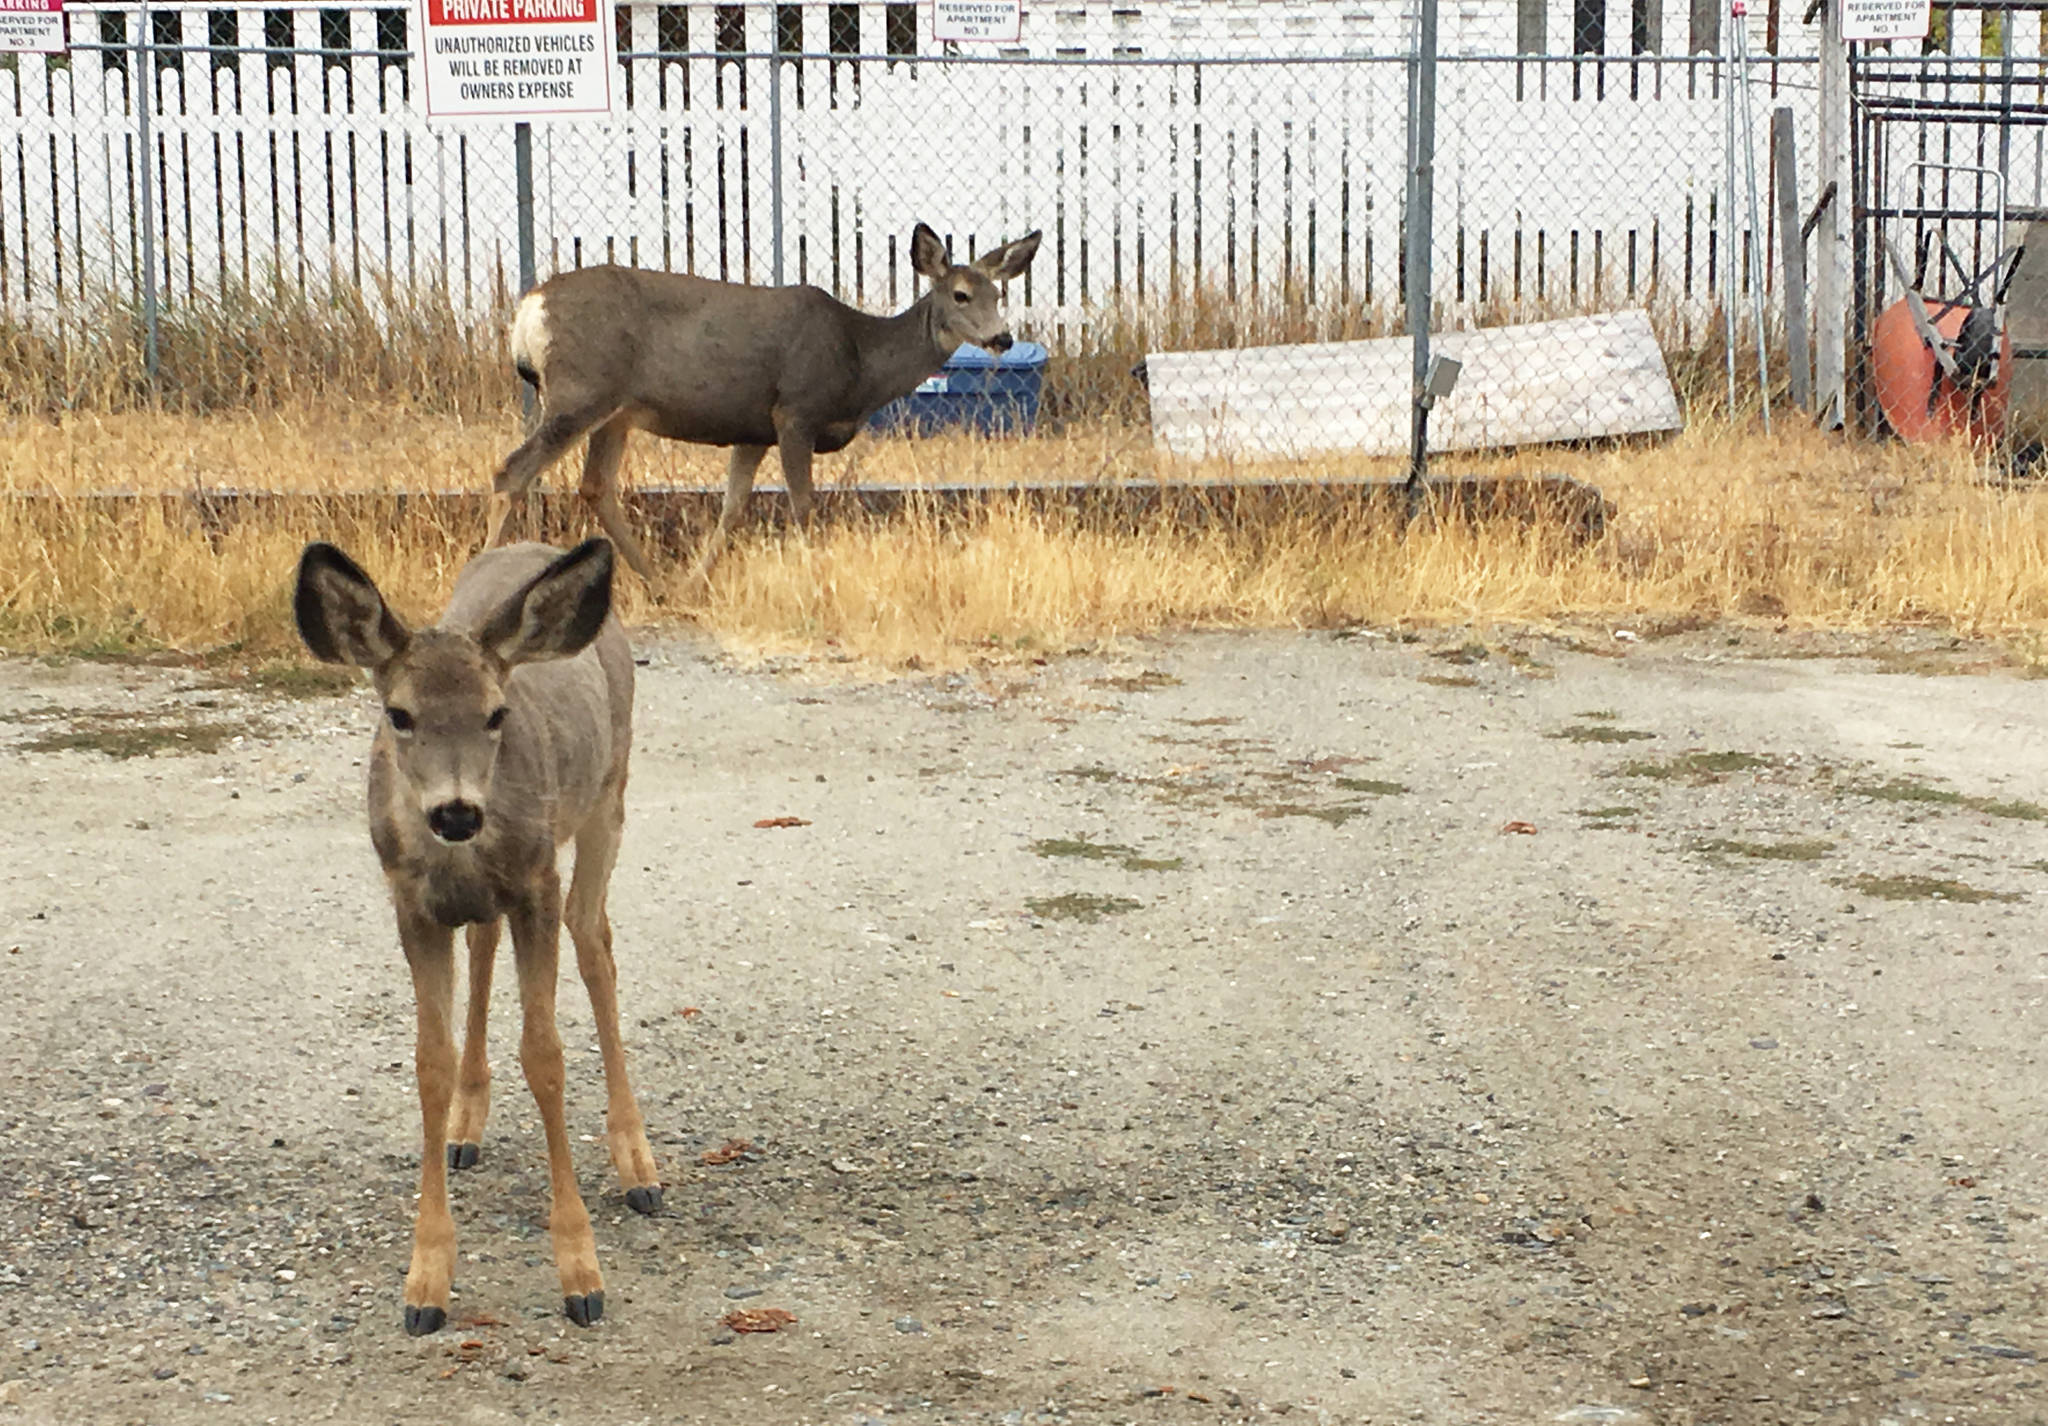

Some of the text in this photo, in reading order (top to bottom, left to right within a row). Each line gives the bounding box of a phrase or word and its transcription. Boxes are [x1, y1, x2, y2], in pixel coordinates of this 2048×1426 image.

[442, 0, 585, 20] PRIVATE PARKING
[939, 4, 1015, 13] RESERVED FOR
[1848, 1, 1926, 11] RESERVED FOR
[0, 16, 58, 25] ERVED FOR
[946, 15, 1006, 24] APARTMENT
[1856, 12, 1917, 22] APARTMENT
[435, 34, 595, 54] UNAUTHORIZED VEHICLES
[449, 58, 582, 77] WILL BE REMOVED AT
[460, 81, 574, 100] OWNERS EXPENSE
